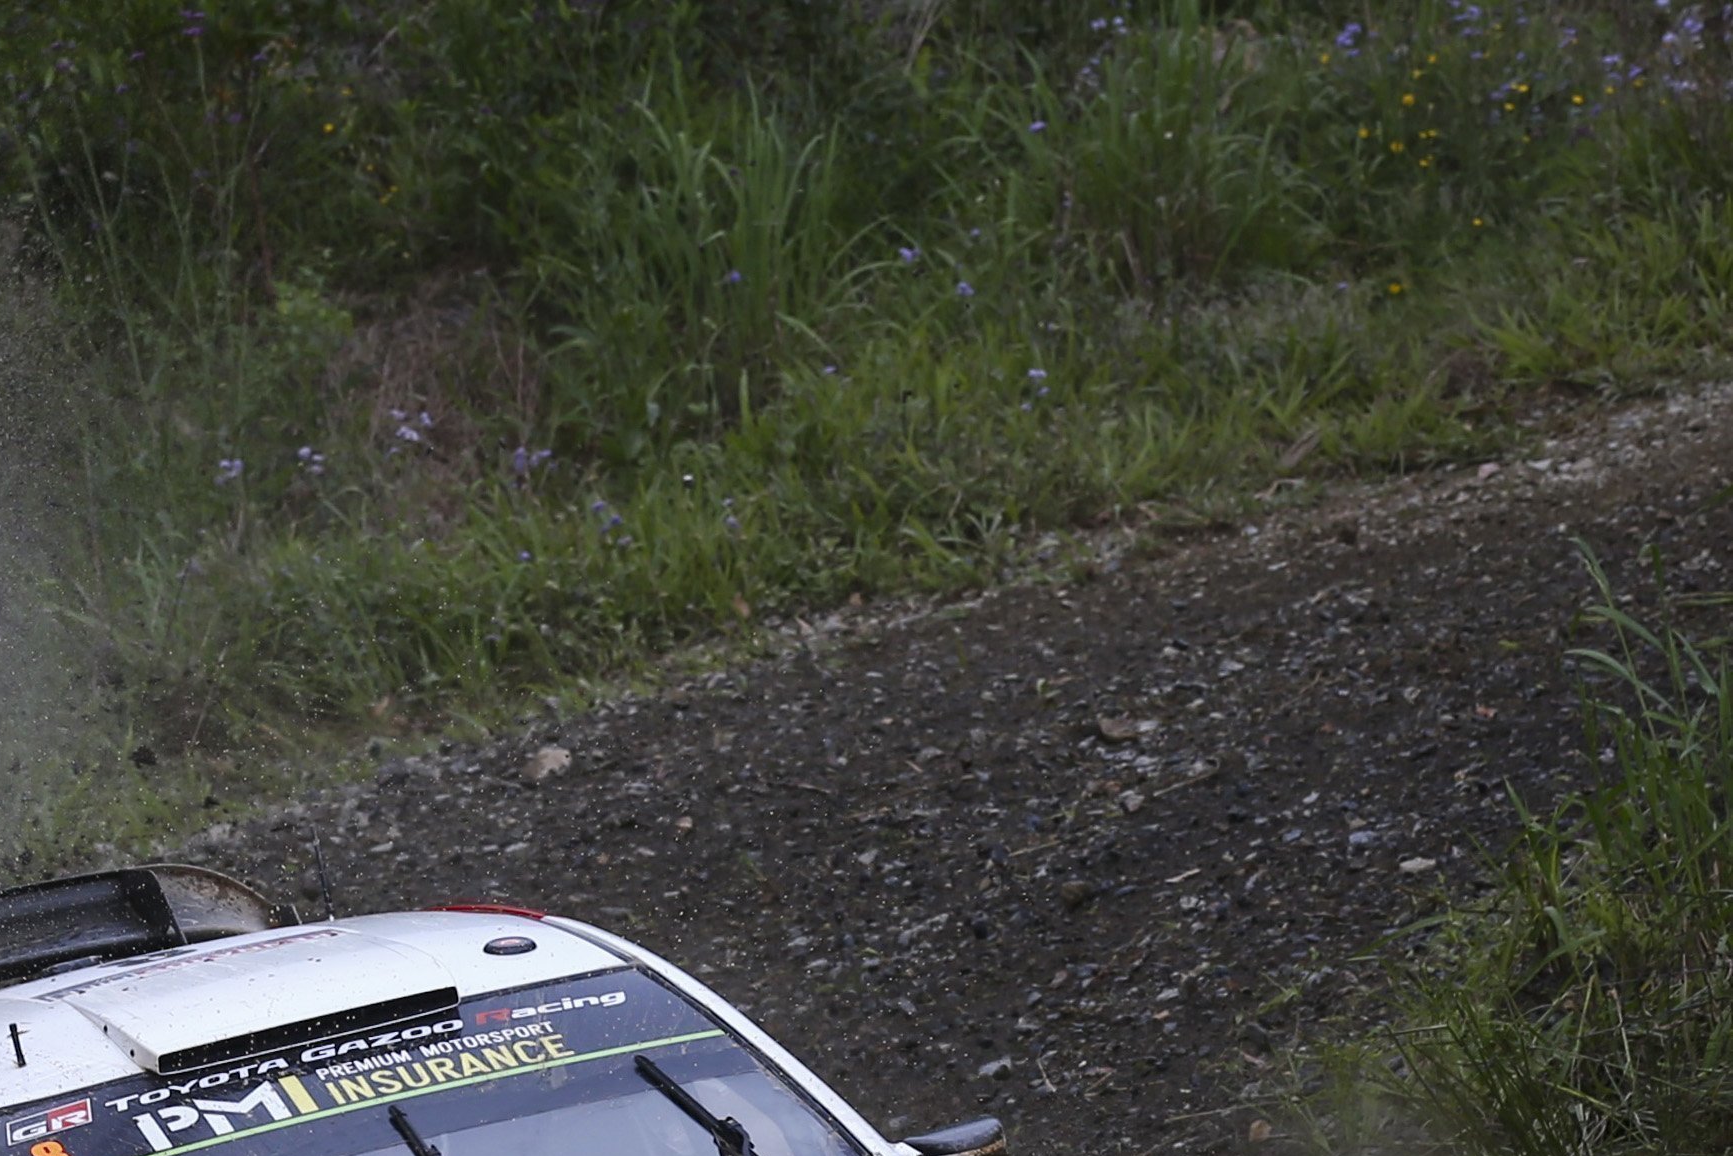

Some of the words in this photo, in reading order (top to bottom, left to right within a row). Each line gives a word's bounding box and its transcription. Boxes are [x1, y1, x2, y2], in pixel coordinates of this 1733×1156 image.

[104, 1056, 288, 1112] TOYOTA
[301, 1019, 464, 1063] GAZOO
[475, 991, 626, 1025] Racing
[315, 1050, 412, 1082] PREMIUM
[423, 1020, 554, 1056] MOTORSPORT
[325, 1033, 575, 1105] INSURANCE
[12, 1108, 88, 1142] GR
[133, 1075, 319, 1152] PMI
